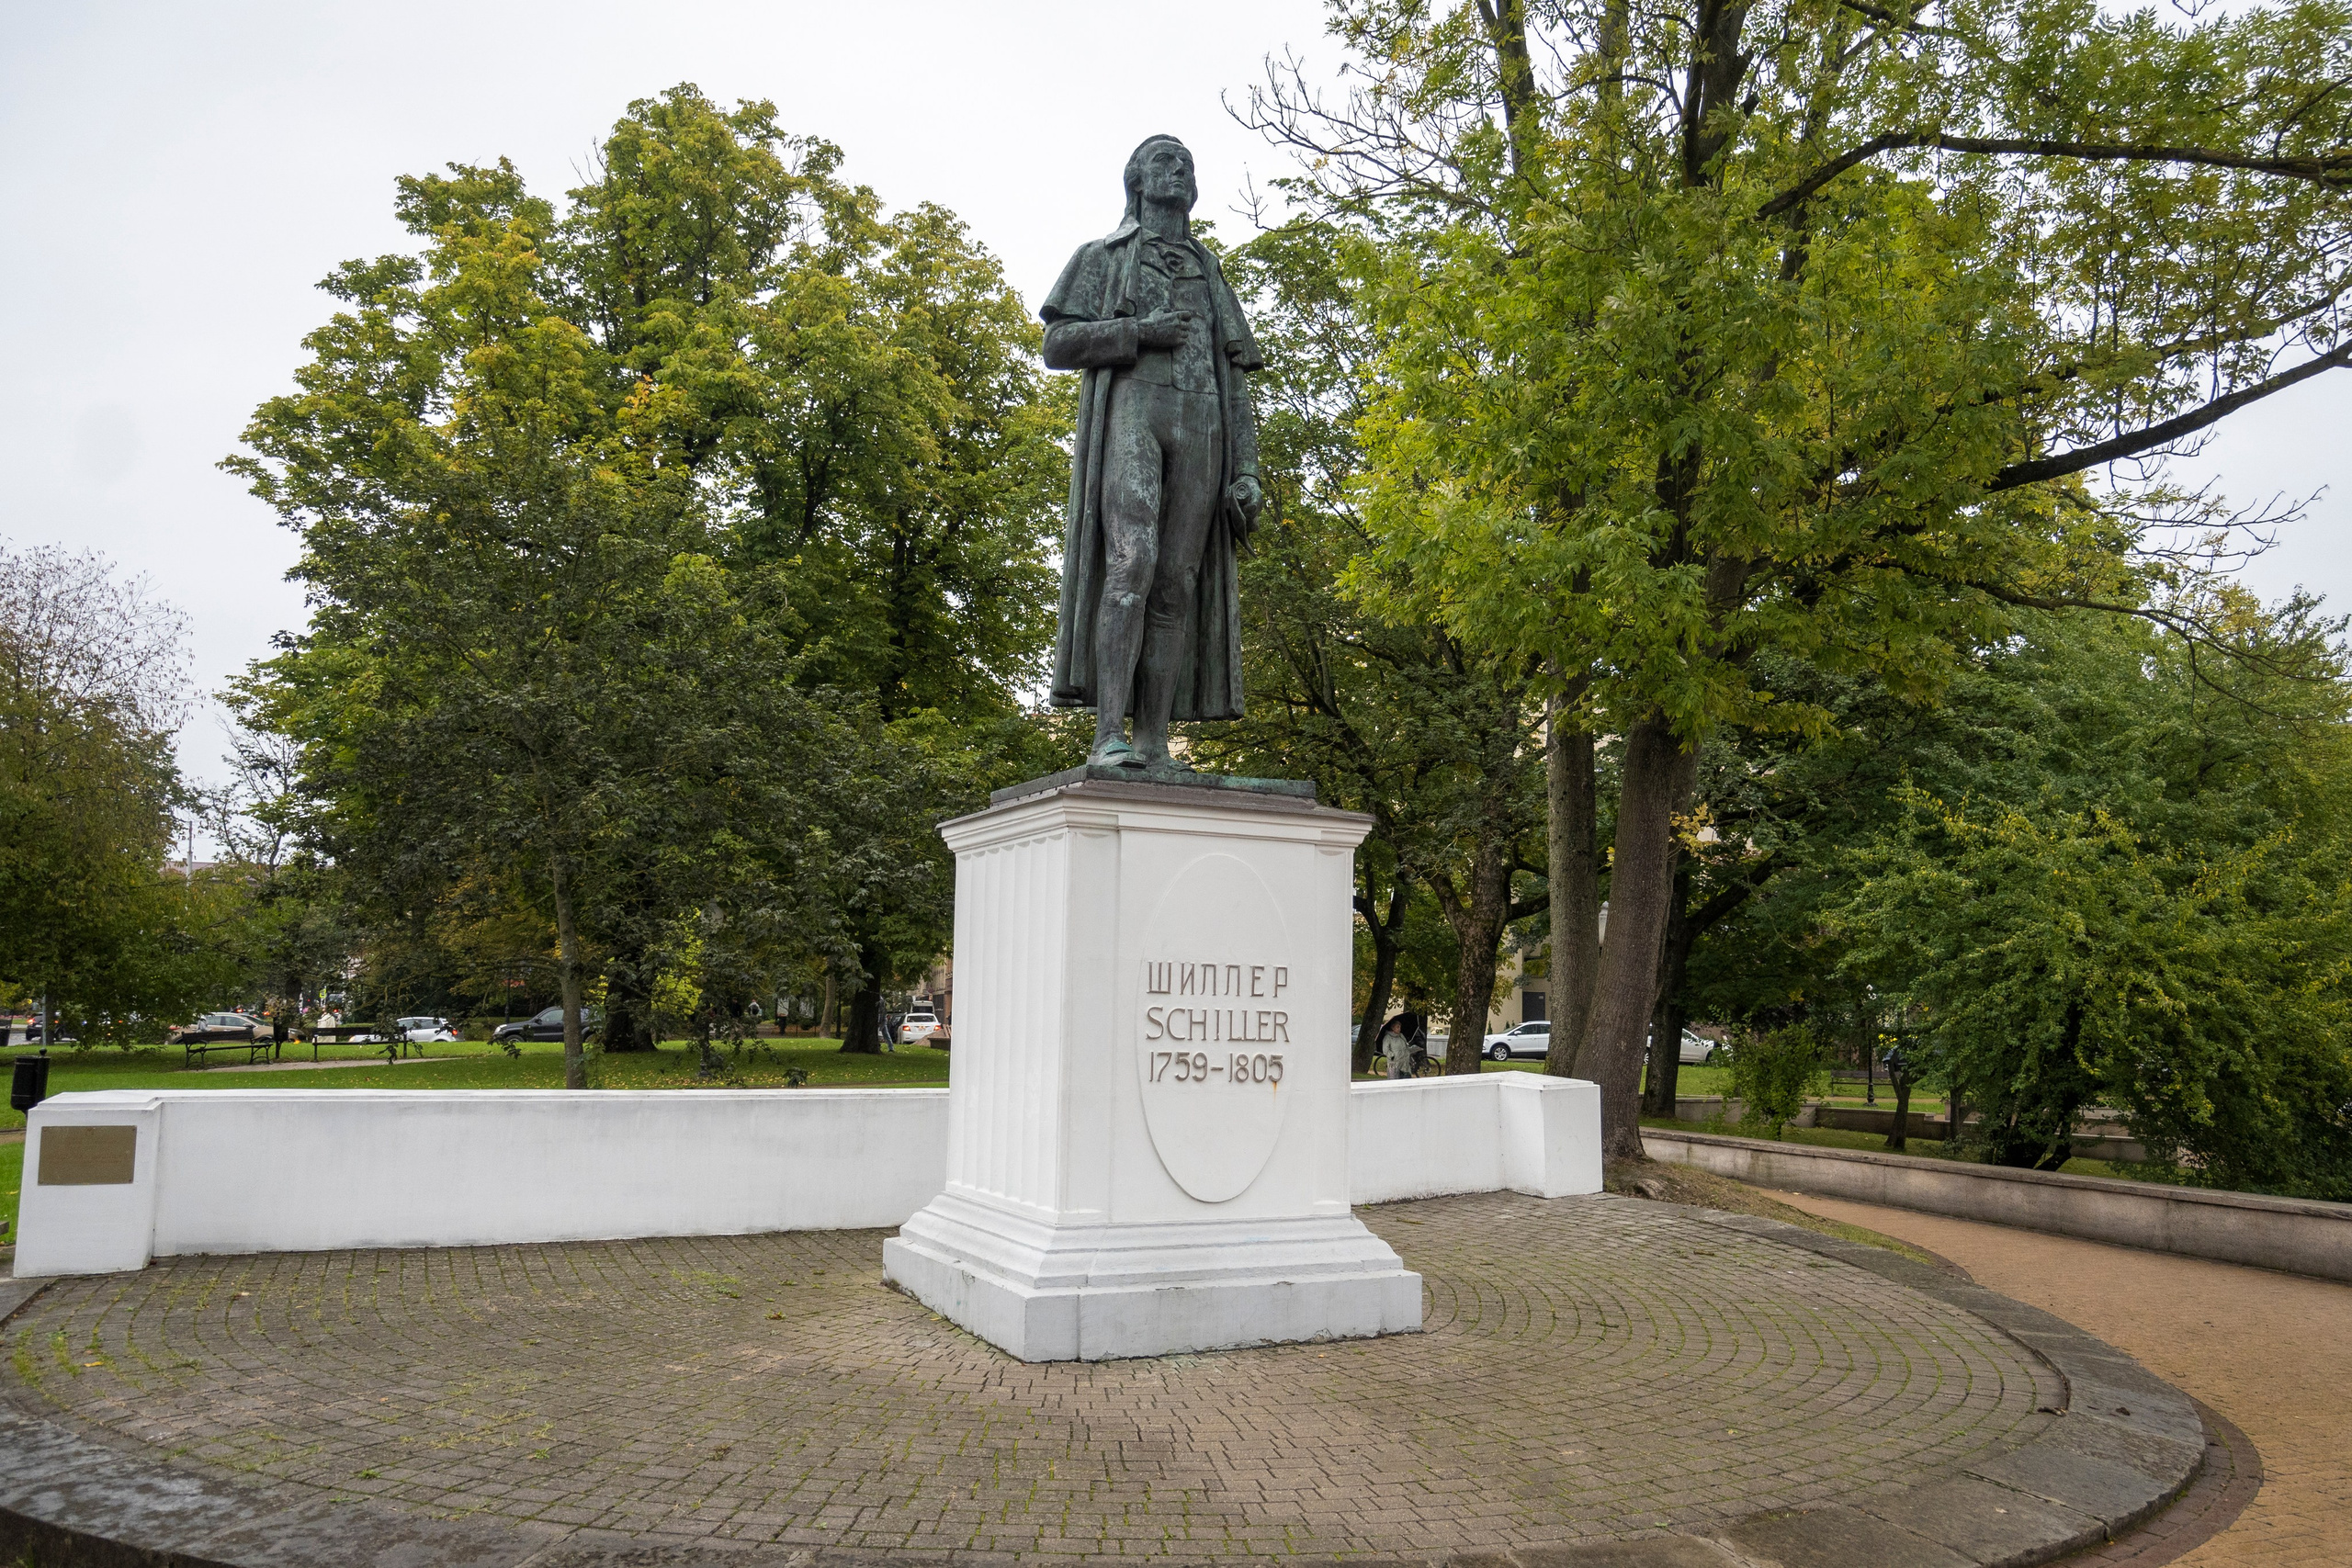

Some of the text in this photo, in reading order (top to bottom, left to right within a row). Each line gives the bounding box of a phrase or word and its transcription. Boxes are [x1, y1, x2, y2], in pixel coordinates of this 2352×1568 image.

[1147, 961, 1288, 998] ШИЛЛЕР
[1146, 1006, 1290, 1043] SCHILLER
[1148, 1051, 1284, 1083] 1759-1805
